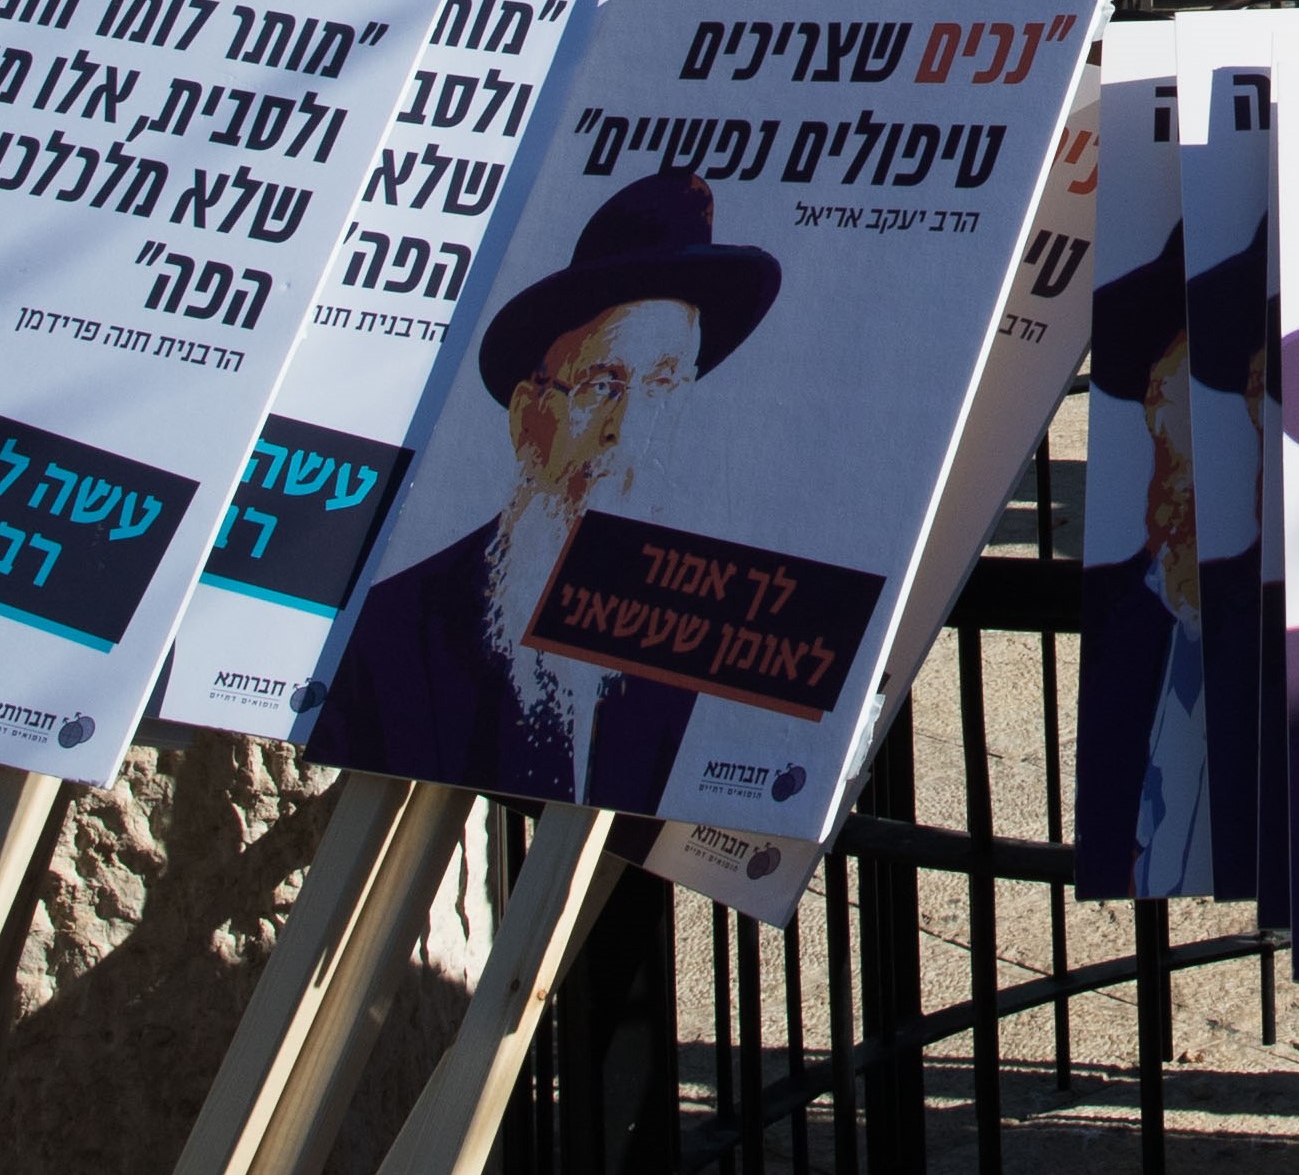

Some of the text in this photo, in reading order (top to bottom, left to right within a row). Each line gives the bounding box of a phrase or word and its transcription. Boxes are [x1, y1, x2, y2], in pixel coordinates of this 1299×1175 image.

[225, 5, 390, 79] "מותר
[680, 14, 1076, 86] "נכים שצריכים
[33, 49, 141, 123] אלו
[125, 78, 348, 164] ולסבית,
[362, 143, 505, 216] שלא
[574, 108, 781, 180] נפשיים"
[780, 110, 1008, 189] טיפולים
[170, 165, 313, 243] שלא
[795, 202, 980, 235] הרב יעקב אריאל
[135, 240, 274, 330] הפה"
[16, 304, 245, 372] הרבנית חנה פרידמן
[355, 312, 450, 343] הרבנית
[28, 462, 163, 541] עשה
[641, 542, 798, 622] לך אמור
[561, 584, 836, 687] לאומן שעשאני
[0, 702, 57, 730] חברות
[214, 671, 287, 696] חברותא
[703, 761, 769, 785] חברותא
[691, 825, 749, 859] חברותא
